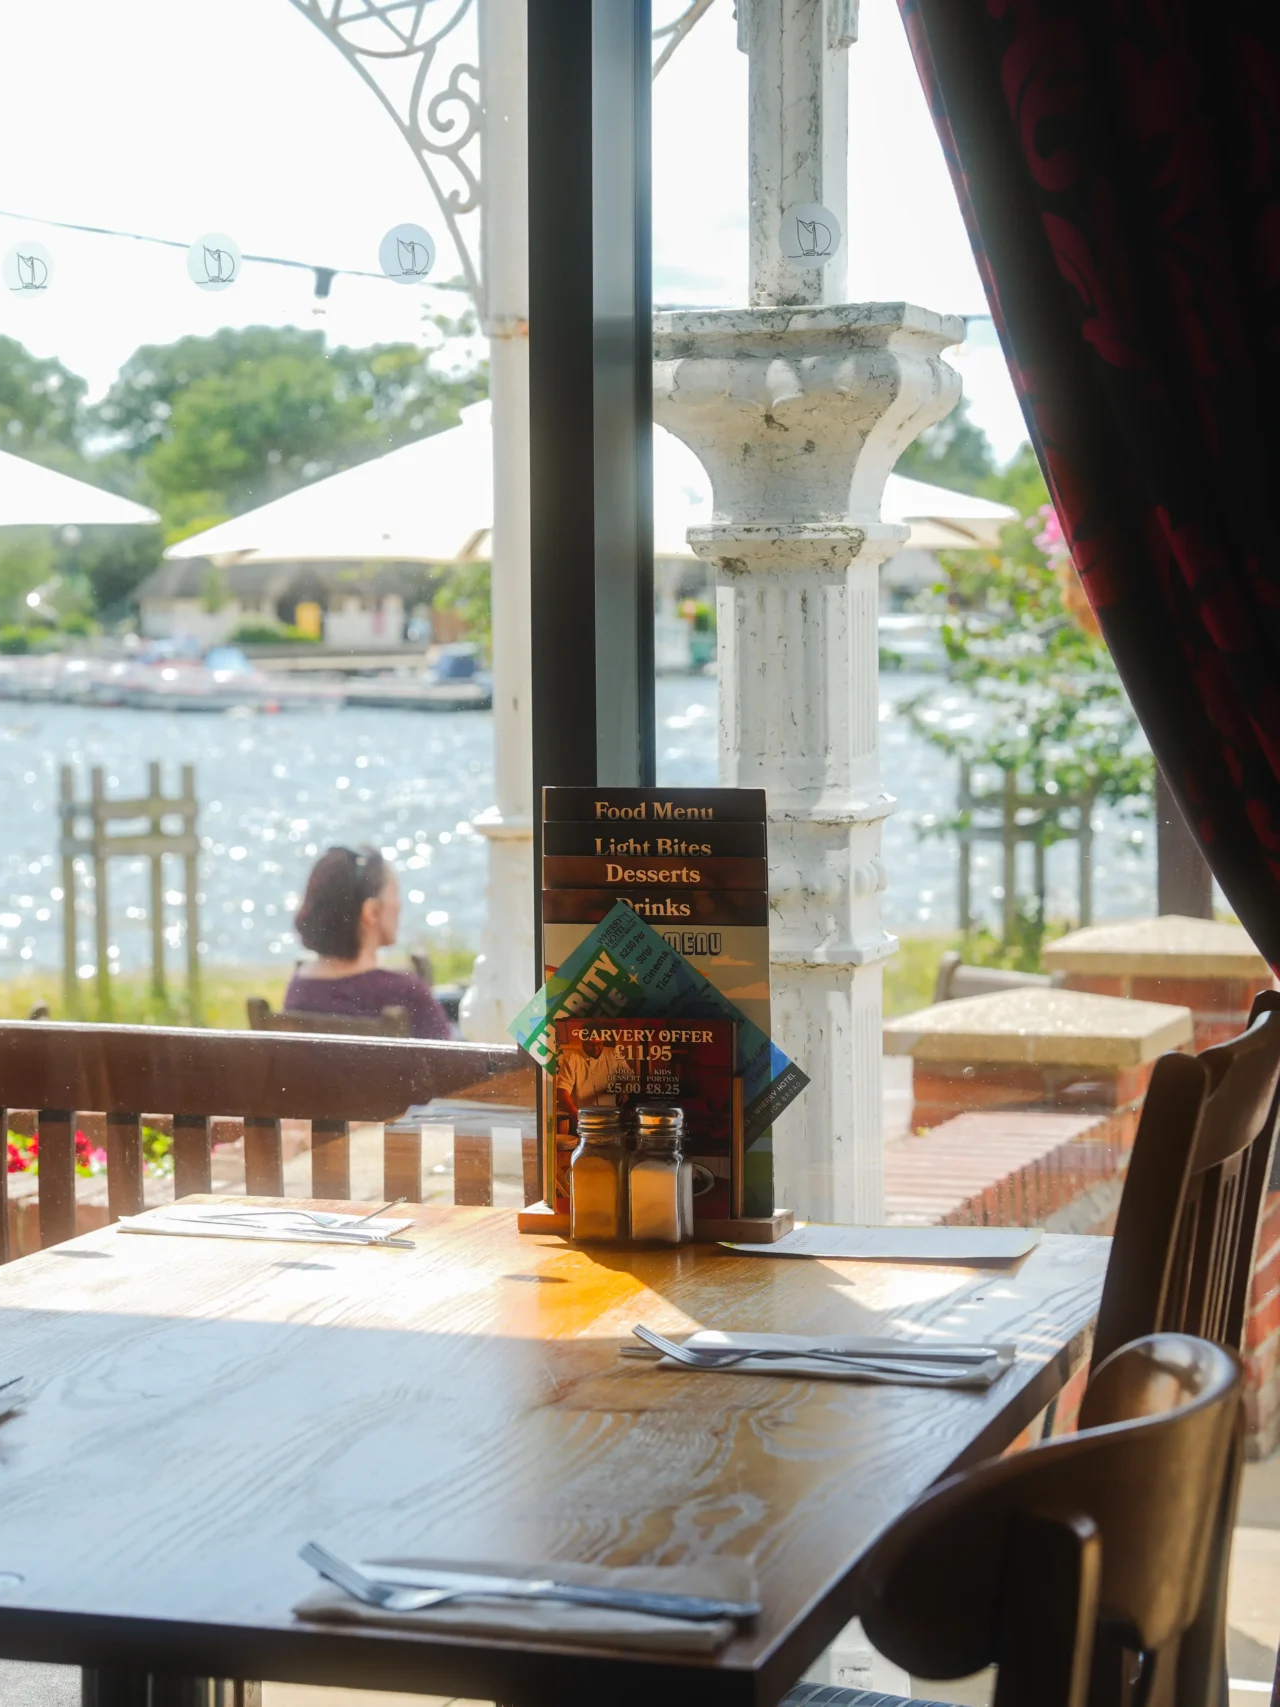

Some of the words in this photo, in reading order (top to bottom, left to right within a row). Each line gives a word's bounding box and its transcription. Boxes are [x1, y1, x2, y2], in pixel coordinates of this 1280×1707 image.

[594, 802, 646, 821] Food
[652, 802, 714, 821] Menu
[594, 838, 651, 856] Light
[656, 838, 712, 856] Bites
[606, 864, 701, 883] Desserts
[596, 916, 622, 944] WHERRY
[605, 924, 625, 946] HOTEL
[632, 930, 645, 942] Per
[662, 933, 721, 956] MENU
[641, 950, 669, 984] Cinema
[655, 959, 682, 990] Tickets
[572, 1029, 655, 1042] CARVERY
[659, 1029, 713, 1043] OFFER
[614, 1044, 672, 1061] £11.95
[607, 1083, 641, 1093] £5.00
[646, 1084, 680, 1095] £8.25
[777, 1072, 796, 1091] HOTEL
[781, 1081, 801, 1101] BROAD
